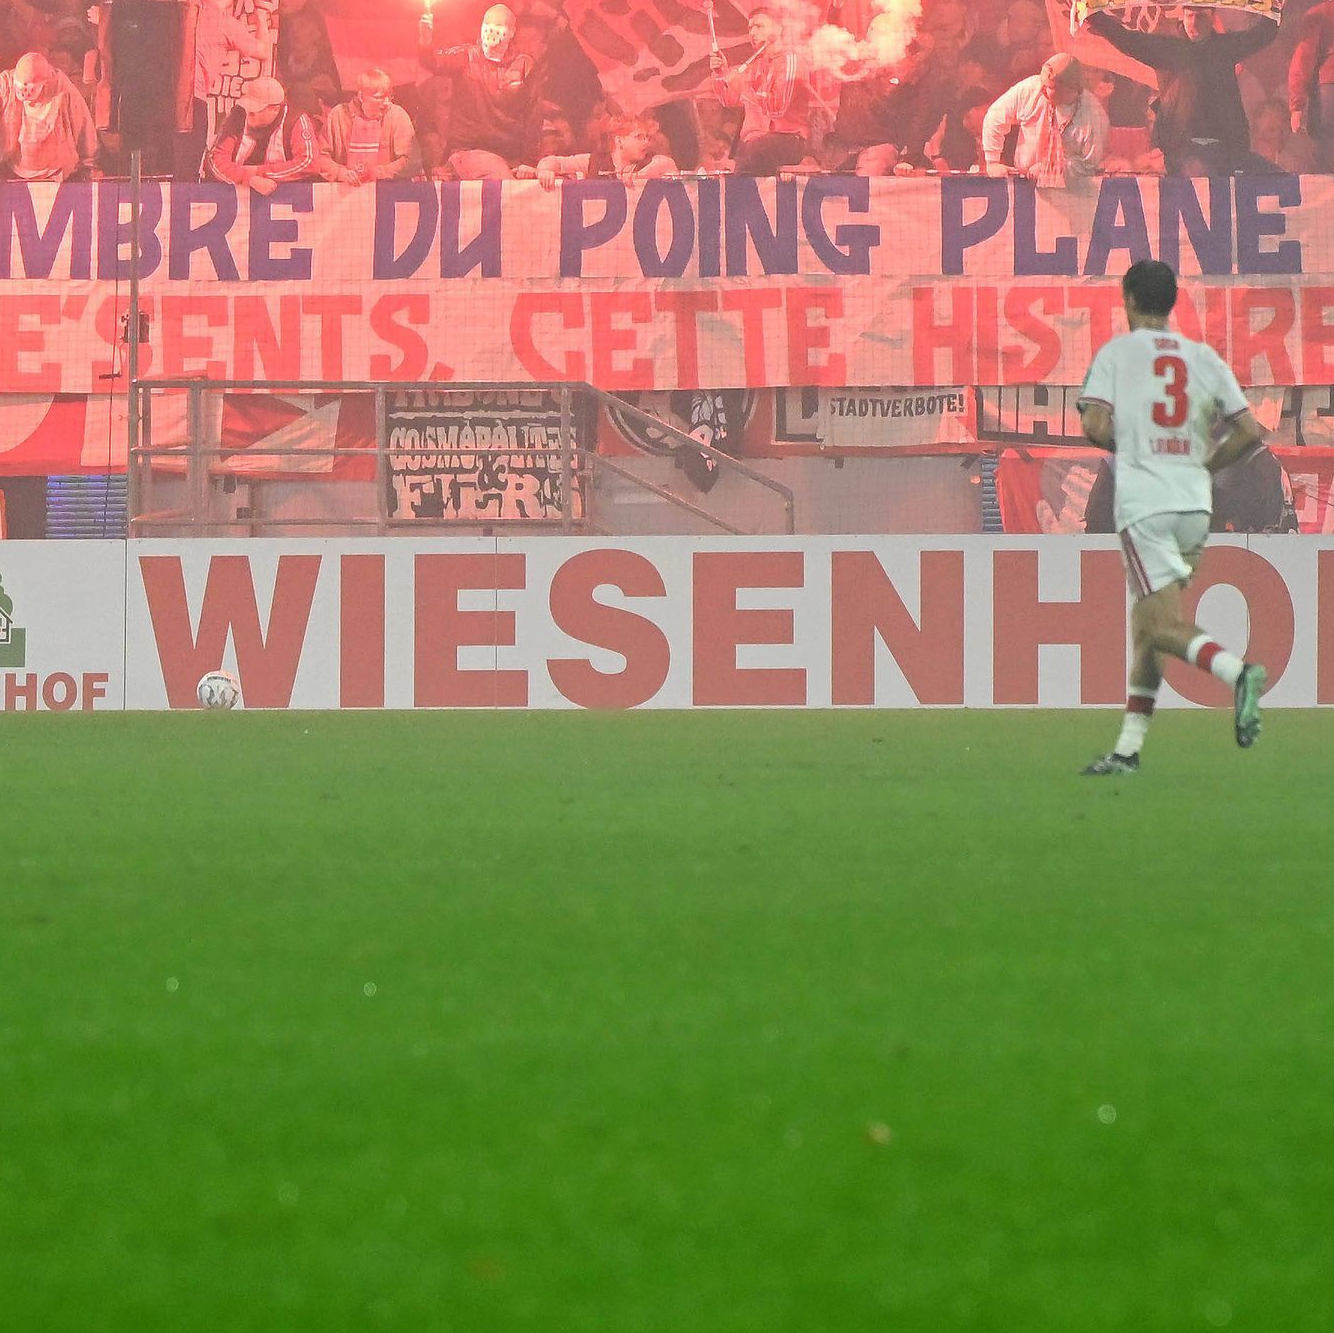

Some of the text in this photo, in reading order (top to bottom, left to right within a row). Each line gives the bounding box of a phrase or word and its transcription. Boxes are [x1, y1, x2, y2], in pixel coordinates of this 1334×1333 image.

[373, 178, 502, 279] DU
[559, 175, 880, 279] POING
[941, 174, 1302, 275] PLANE
[511, 286, 844, 388] CETTE
[829, 394, 966, 419] STADTVERBOTE!
[1152, 355, 1189, 429] 3
